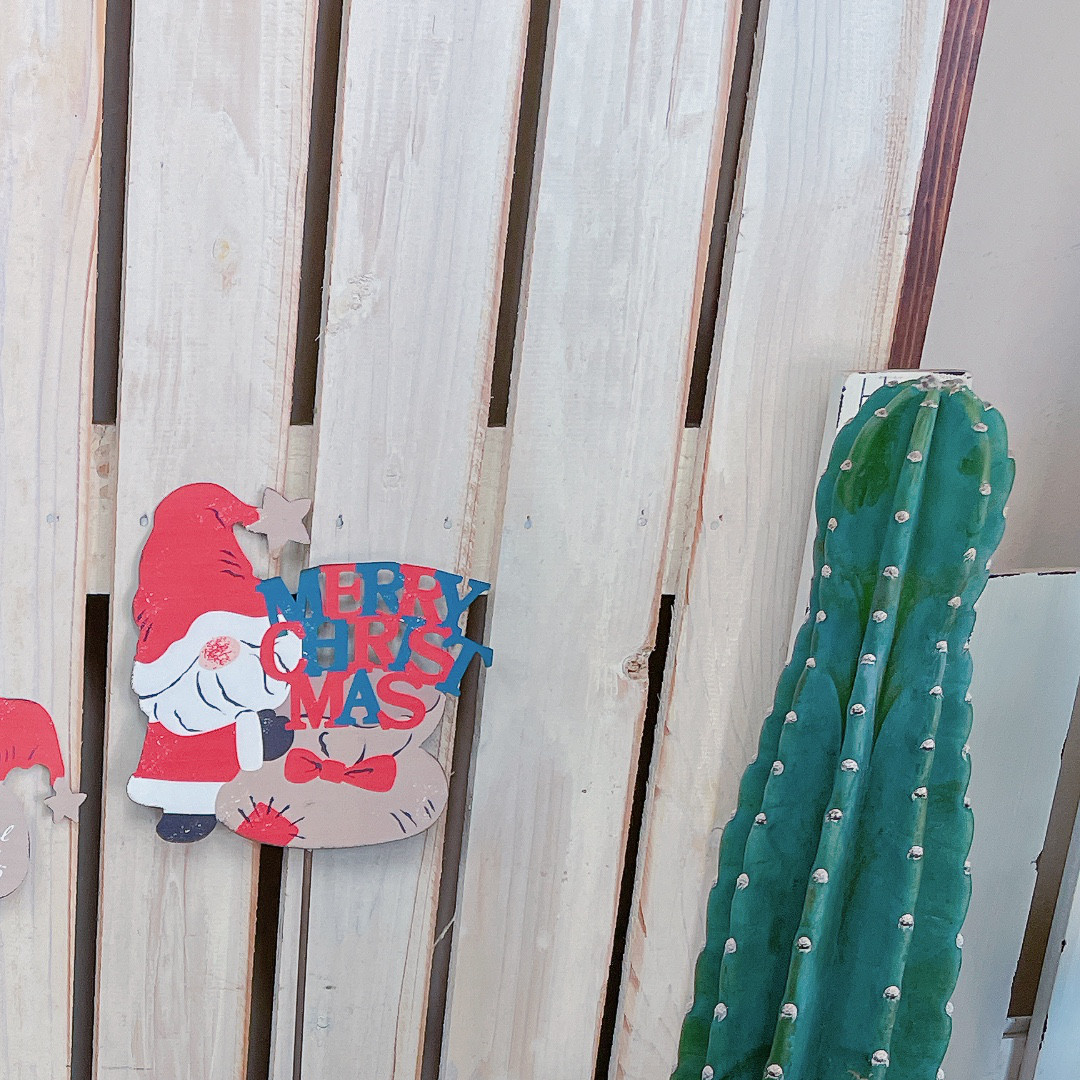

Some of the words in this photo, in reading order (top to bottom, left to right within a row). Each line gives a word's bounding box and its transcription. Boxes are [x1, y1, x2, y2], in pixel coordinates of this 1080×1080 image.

[256, 561, 491, 628] MERRY
[260, 615, 494, 697] CHRIST
[285, 670, 427, 730] MAS
